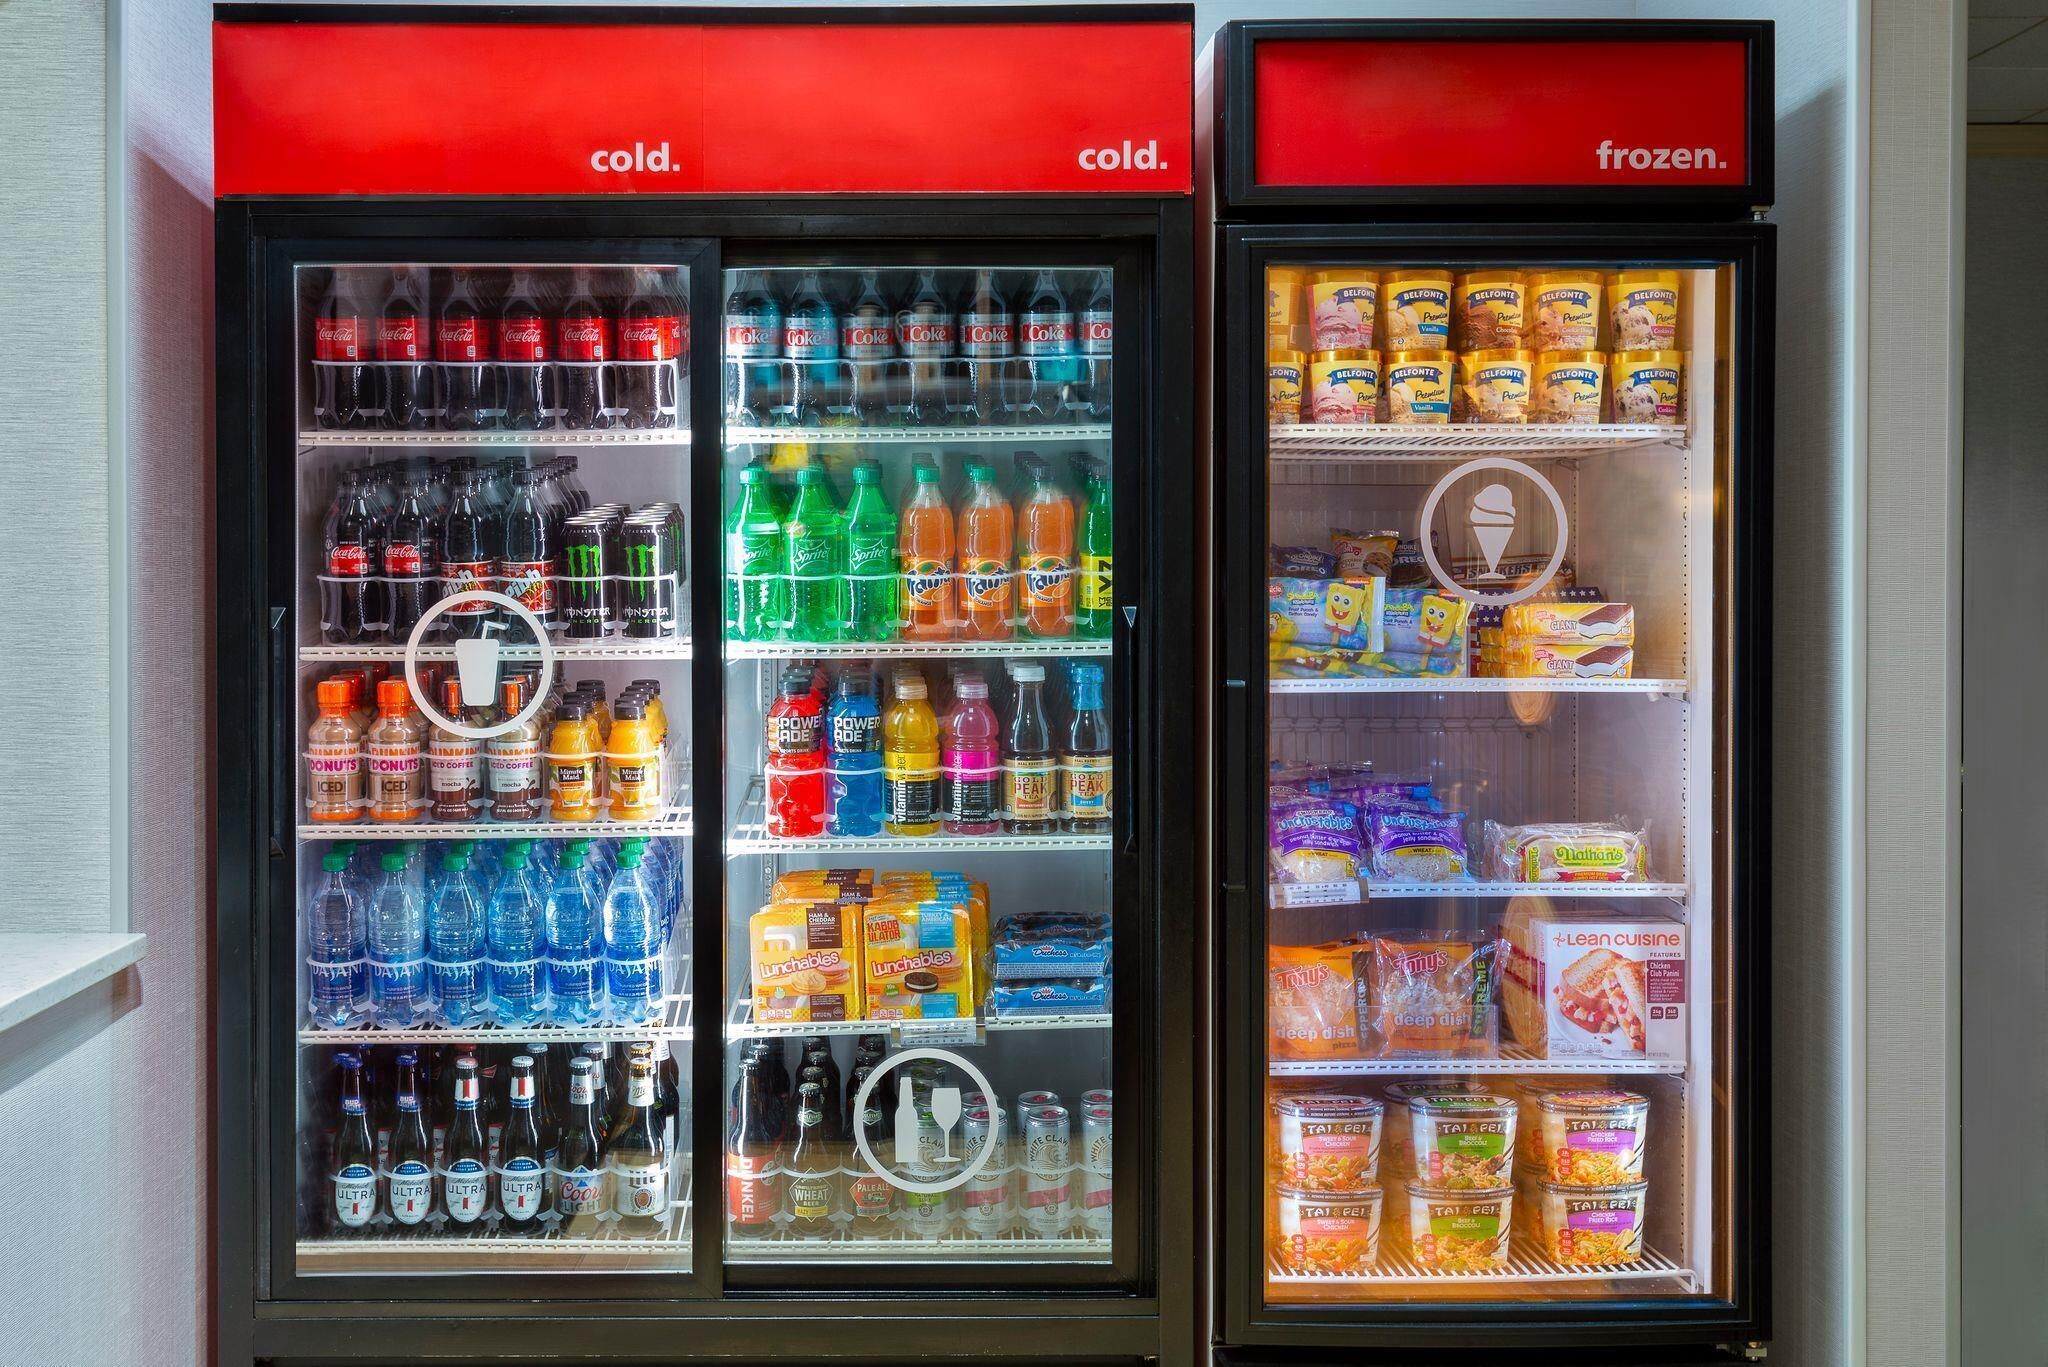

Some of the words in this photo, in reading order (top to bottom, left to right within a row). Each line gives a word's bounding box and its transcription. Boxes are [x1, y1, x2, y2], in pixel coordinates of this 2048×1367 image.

[590, 141, 681, 173] cold.
[1078, 140, 1167, 171] cold.
[1596, 140, 1727, 169] frozen.
[1343, 289, 1375, 298] BELFONTE
[1403, 290, 1444, 300] BELFONTE
[1475, 290, 1515, 300] BELFONTE
[1541, 290, 1584, 302] BELFONTE
[1634, 290, 1674, 300] BELFONTE
[852, 328, 888, 345] Coke
[910, 325, 946, 342] Coke
[972, 325, 1008, 342] Coke
[1029, 325, 1065, 341] Coke
[1091, 324, 1112, 339] Co
[787, 329, 822, 347] Coke
[1336, 369, 1374, 379] BELFONTE
[1394, 368, 1435, 379] BELFONTE
[1480, 369, 1522, 379] BELFONTE
[1551, 369, 1593, 379] BELFONTE
[1640, 370, 1677, 379] BELFONTE
[795, 549, 828, 562] Sprite
[853, 549, 887, 562] Sprite
[1550, 621, 1577, 631] GIANT
[1547, 660, 1574, 670] GIANT
[835, 715, 881, 730] POWER
[780, 729, 810, 743] ADE
[835, 730, 862, 743] ADE
[310, 759, 357, 772] DONUTS
[372, 759, 419, 771] DONUTS
[446, 761, 474, 769] COFFEE
[506, 761, 534, 769] COFFEE
[1014, 783, 1047, 794] PEAK
[1070, 780, 1104, 792] PEAK
[1555, 846, 1624, 861] Nathan's
[867, 920, 899, 931] KABOB
[868, 930, 901, 942] ULATOR
[1032, 948, 1068, 957] Duchess
[760, 952, 839, 979] Lunchables
[872, 950, 952, 976] Lunchables
[1392, 949, 1448, 977] Tony's
[1274, 963, 1329, 990] Tony's
[1032, 991, 1068, 1000] Duchess
[1394, 1013, 1436, 1029] deep
[1440, 1012, 1471, 1027] dish
[1276, 1026, 1318, 1043] deep
[1321, 1025, 1355, 1040] dish
[1307, 1124, 1331, 1135] TAI
[1344, 1124, 1367, 1133] PEI
[1443, 1124, 1467, 1133] TAI
[1480, 1123, 1502, 1133] PEI
[1572, 1121, 1596, 1130] TAI
[919, 1136, 945, 1149] CLAW
[1029, 1136, 1043, 1162] WHITE
[1045, 1134, 1069, 1147] CLAW
[1091, 1136, 1106, 1162] WHITE
[392, 1186, 431, 1197] ULTRA
[447, 1184, 486, 1195] ULTRA
[503, 1182, 542, 1192] ULTRA
[561, 1181, 604, 1201] Coors
[857, 1184, 875, 1193] PALE
[878, 1184, 890, 1192] ALE
[337, 1188, 376, 1200] ULTRA
[794, 1189, 829, 1201] WHEAT
[1435, 1206, 1459, 1216] TAI
[1472, 1206, 1495, 1215] PEI
[1573, 1201, 1597, 1211] TAI
[1610, 1200, 1631, 1210] PEI
[1306, 1207, 1330, 1217] TAI
[1343, 1207, 1365, 1217] PEI
